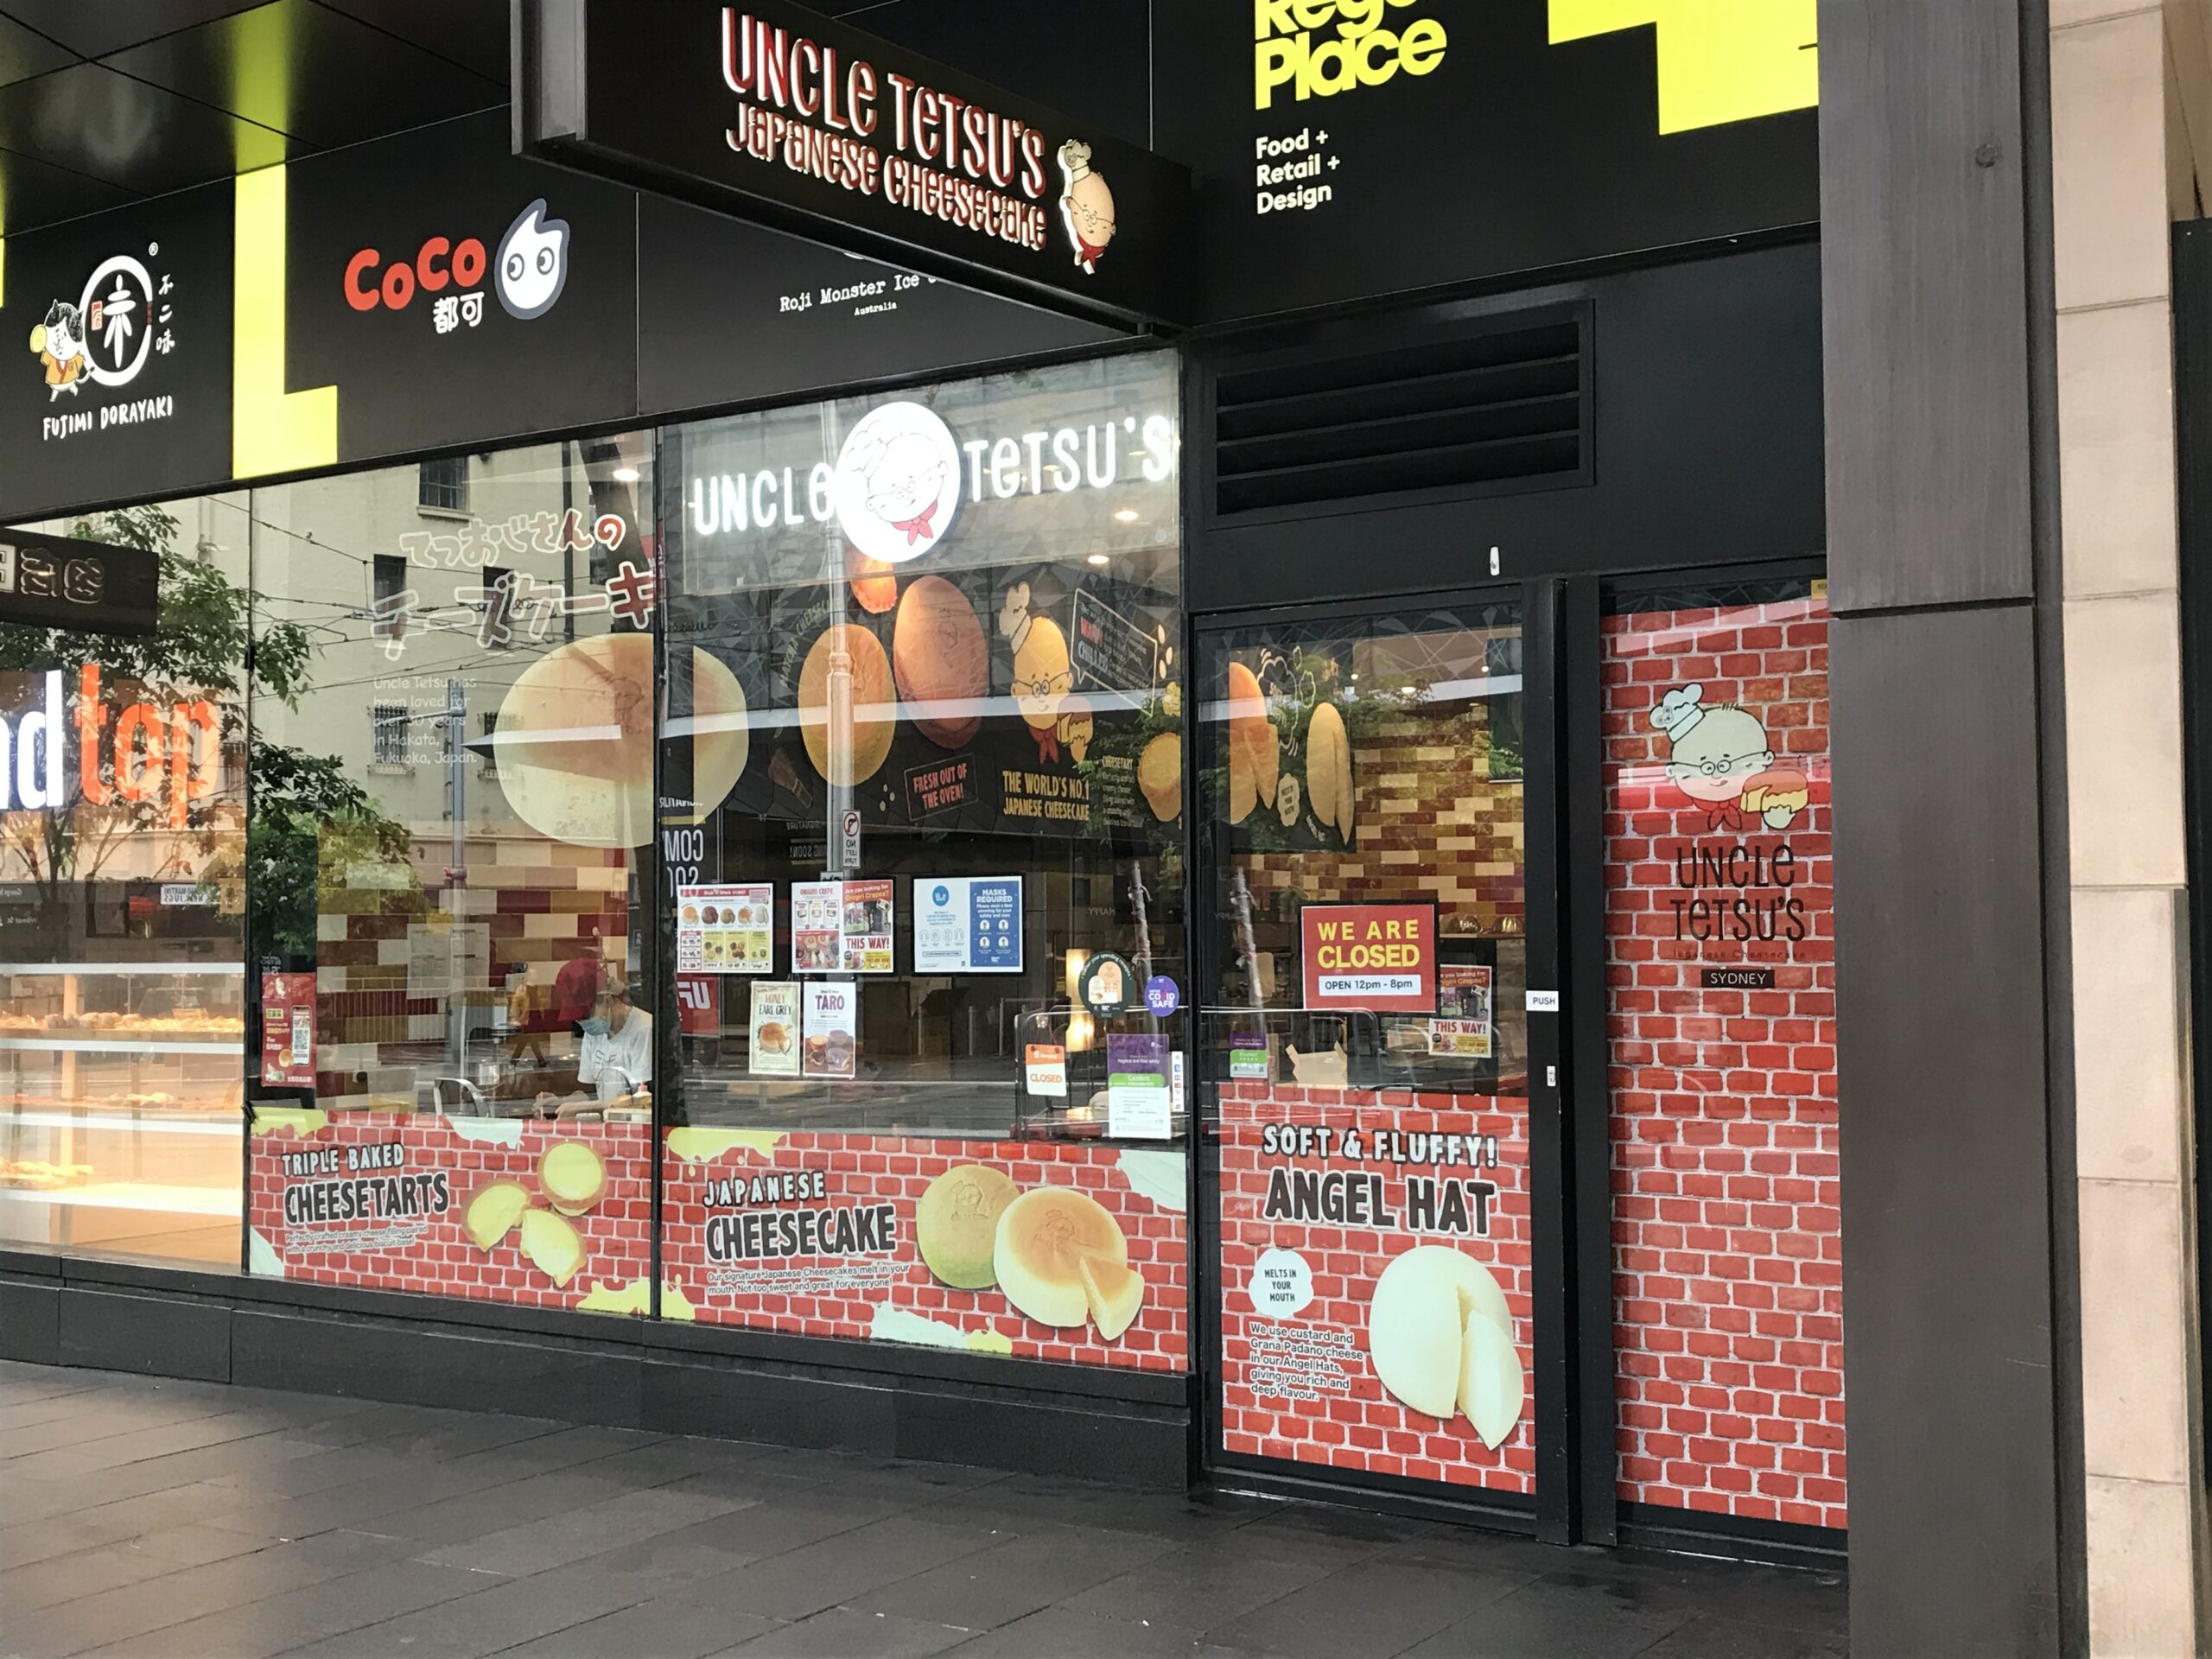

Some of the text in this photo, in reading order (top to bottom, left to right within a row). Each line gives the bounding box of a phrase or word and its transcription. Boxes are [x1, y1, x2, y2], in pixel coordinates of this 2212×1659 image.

[1255, 0, 1418, 40] Reg
[1255, 18, 1447, 110] Place
[1255, 128, 1328, 159] Food +
[1257, 153, 1340, 187] Retail +
[1257, 184, 1332, 214] Design
[779, 274, 919, 312] Roji Monster Ice
[433, 291, 485, 334] 都可
[854, 302, 897, 316] Australia
[43, 395, 173, 441] FUJIMI DORAYAKI
[399, 508, 626, 568] てつおじさんの
[373, 676, 477, 689] Uncle Tetsu has
[373, 696, 407, 707] been
[410, 695, 446, 707] loved
[428, 716, 466, 729] years
[373, 733, 440, 747] in Hakata,
[374, 751, 478, 767] Fukuoka, Japan.
[912, 763, 967, 793] FRESH OUT OF
[1002, 771, 1090, 800] THE WORLD'S NO.1
[922, 783, 964, 810] THE OVEN!
[1003, 797, 1090, 820] JAPANESE CHEESECAKE
[1317, 919, 1419, 941] WE ARE
[846, 937, 890, 950] THIS WAY!
[1318, 944, 1420, 969] CLOSED
[1325, 981, 1351, 990] OPEN
[1355, 980, 1381, 991] 12pm
[1390, 979, 1413, 990] 8pm
[1710, 972, 1766, 985] SYDNEY
[765, 994, 785, 1004] HONEY
[815, 995, 845, 1011] TARO
[1533, 996, 1555, 1005] PUSH
[759, 1004, 792, 1015] EARL GREY
[1434, 1021, 1486, 1034] THIS WAY!
[1030, 1073, 1063, 1084] CLOSED
[1262, 1125, 1498, 1167] SOFT & FLUFFY!
[282, 1143, 404, 1176] TRIPLE BAKED
[285, 1173, 448, 1224] CHEESETARTS
[703, 1172, 825, 1206] JAPANESE
[1265, 1169, 1496, 1235] ANGEL HAT
[339, 1230, 362, 1240] creamy
[364, 1228, 387, 1238] cheese
[407, 1224, 427, 1236] paired
[707, 1205, 896, 1260] CHEESECAKE
[307, 1243, 332, 1254] crunchy
[708, 1273, 722, 1281] Our
[765, 1270, 801, 1281] Japanese
[804, 1267, 857, 1277] Cheesecakes
[860, 1265, 878, 1274] melt
[890, 1264, 910, 1274] your
[1264, 1268, 1296, 1278] MELTS IN
[738, 1284, 752, 1293] Not
[753, 1284, 767, 1293] too
[769, 1283, 792, 1293] sweet
[794, 1282, 810, 1292] and
[812, 1281, 835, 1292] great
[836, 1280, 849, 1289] for
[850, 1279, 892, 1290] everyone!
[1272, 1281, 1291, 1290] YOUR
[1269, 1293, 1295, 1302] MOUTH
[1250, 1323, 1353, 1344] We use custard and
[1250, 1338, 1363, 1360] Grana Padano cheese
[1251, 1354, 1343, 1375] in our Angel Hats,
[1250, 1369, 1350, 1389] giving you rich and
[1250, 1383, 1319, 1402] deep flavour.
